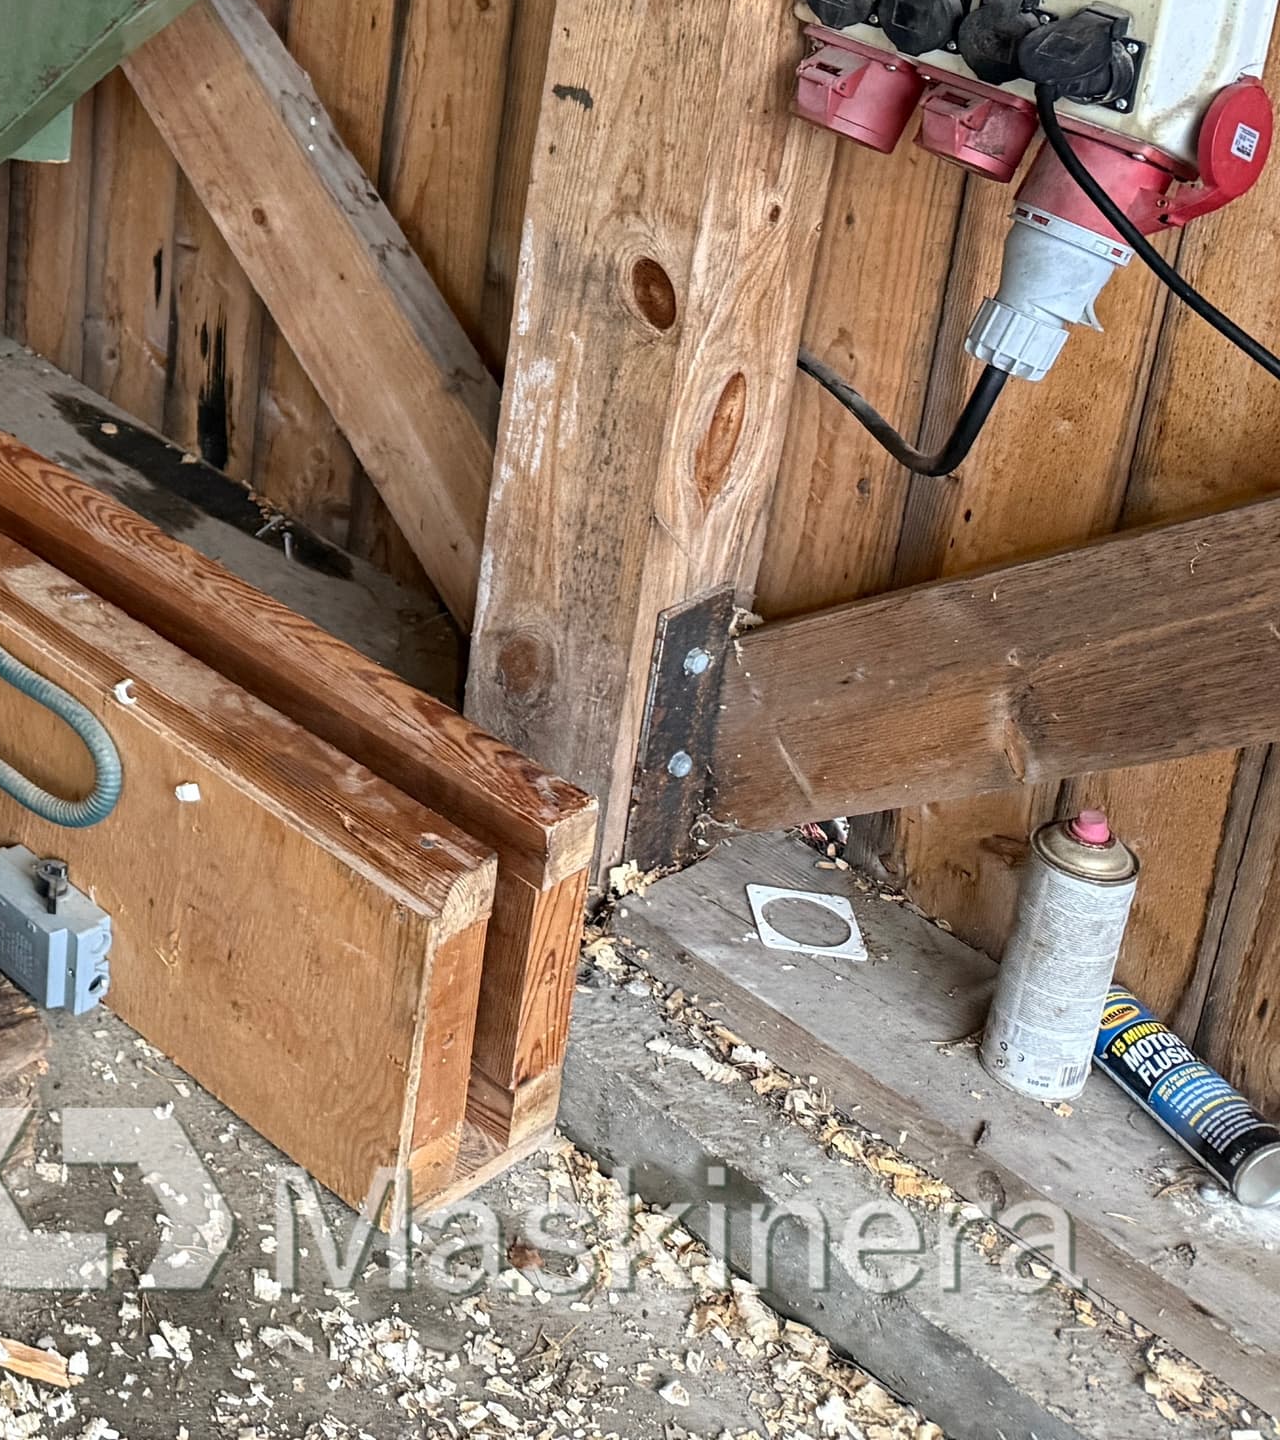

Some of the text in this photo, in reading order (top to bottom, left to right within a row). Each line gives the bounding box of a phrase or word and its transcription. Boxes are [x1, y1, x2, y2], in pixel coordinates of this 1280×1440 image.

[1111, 1038, 1126, 1057] 15
[1122, 1031, 1187, 1072] MOTOR
[1137, 1044, 1196, 1087] FLUSH
